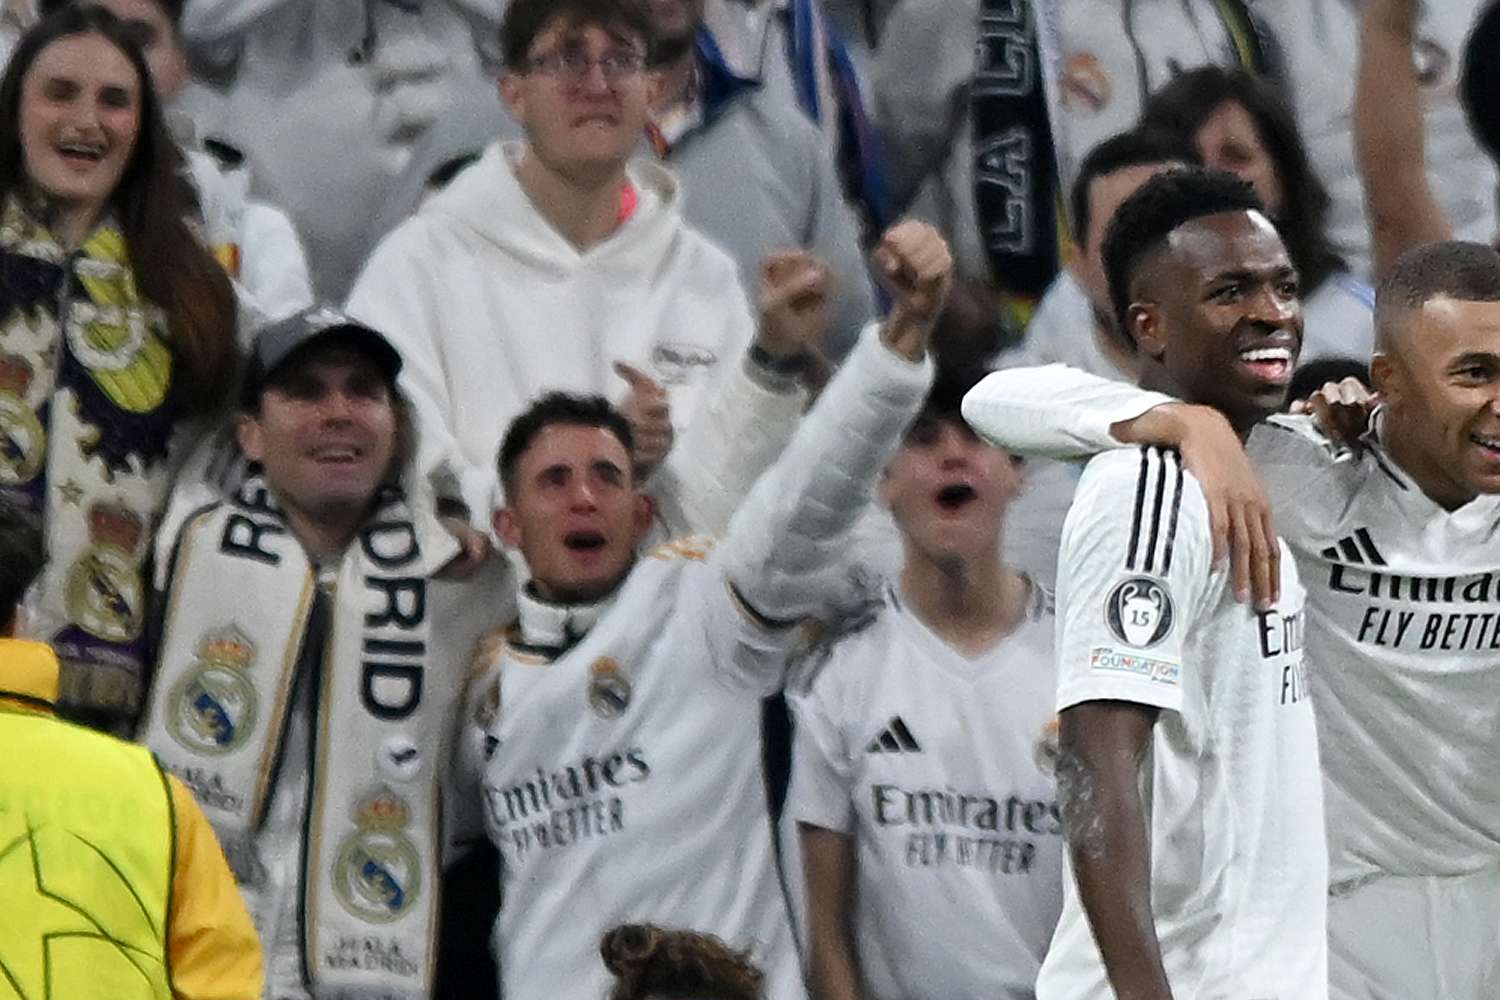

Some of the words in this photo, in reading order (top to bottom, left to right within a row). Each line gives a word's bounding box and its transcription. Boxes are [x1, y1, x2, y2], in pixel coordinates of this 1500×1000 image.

[359, 521, 427, 722] DRID
[1130, 609, 1150, 627] 15
[1357, 606, 1413, 647] FLY
[872, 784, 1064, 835] Emirates
